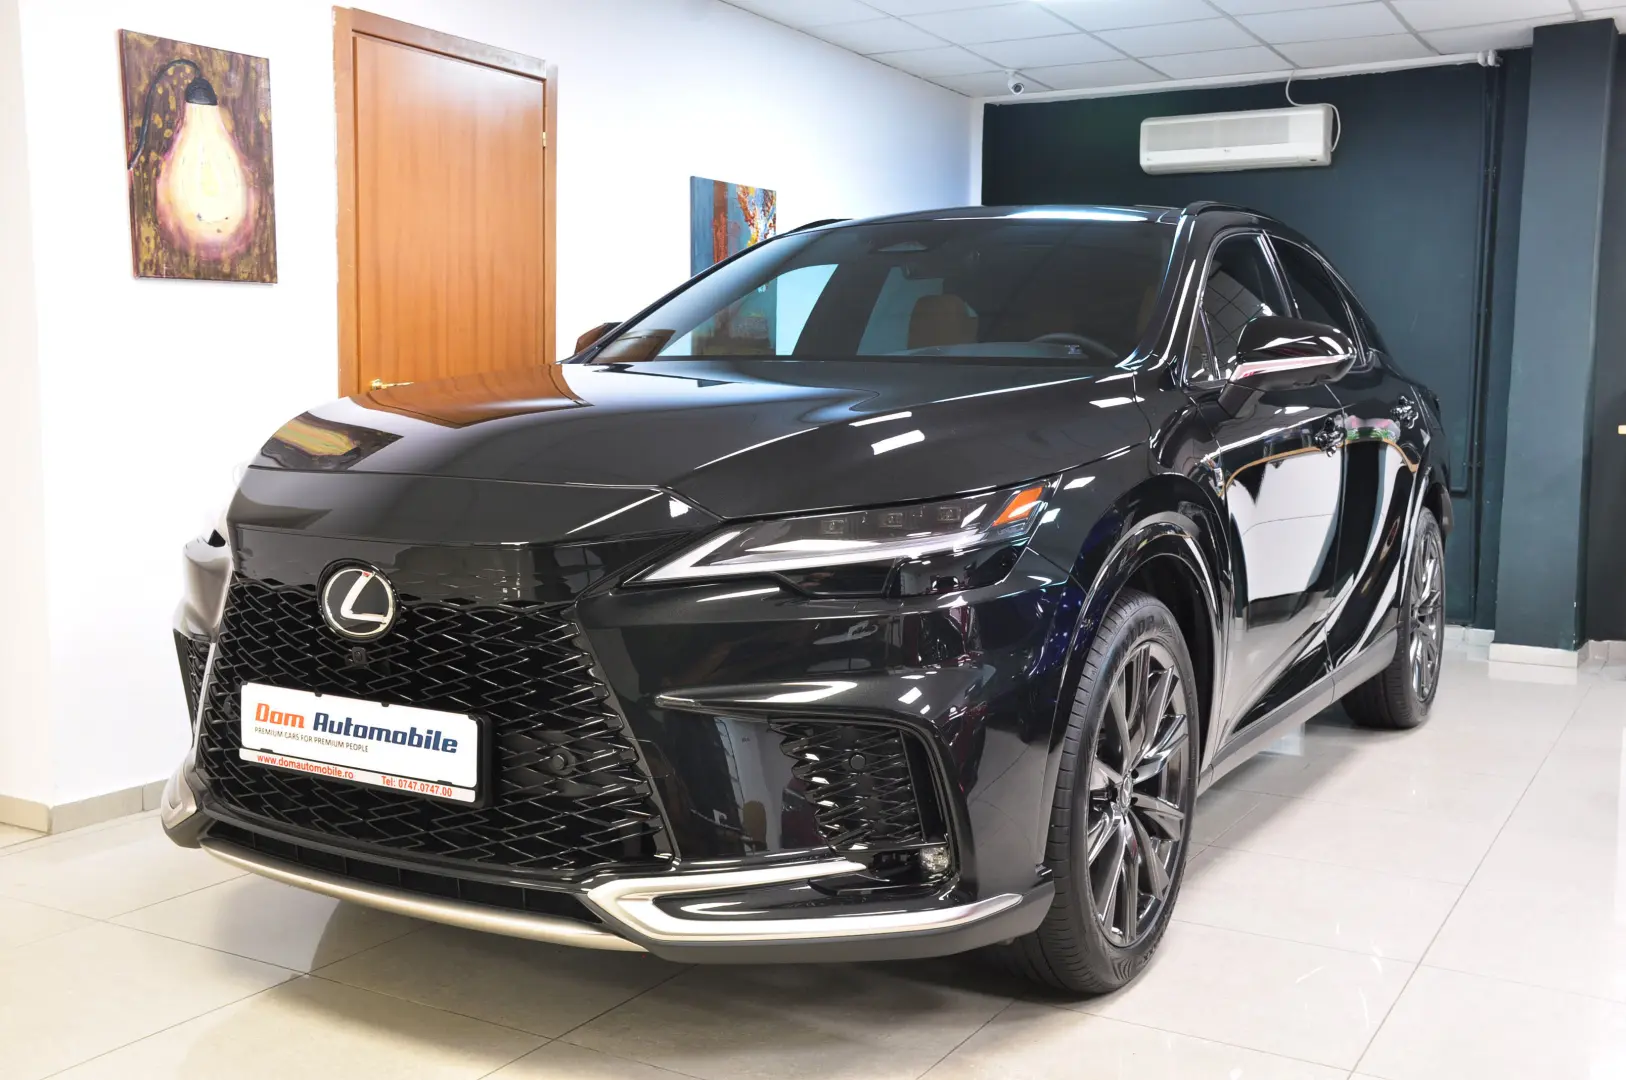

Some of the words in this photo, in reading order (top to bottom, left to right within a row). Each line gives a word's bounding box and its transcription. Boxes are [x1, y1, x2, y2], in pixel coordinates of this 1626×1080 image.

[254, 726, 283, 738] PREMIUM
[285, 732, 300, 741] CARS
[301, 735, 313, 743] FOR
[314, 738, 344, 748] PREMIUM
[346, 742, 369, 753] PEOPLE
[255, 703, 304, 728] Dom
[313, 712, 458, 753] Automobile
[257, 755, 354, 779] www.domautomobile.ro
[381, 775, 396, 787] Tel:
[398, 778, 453, 797] 0747.0747.00
